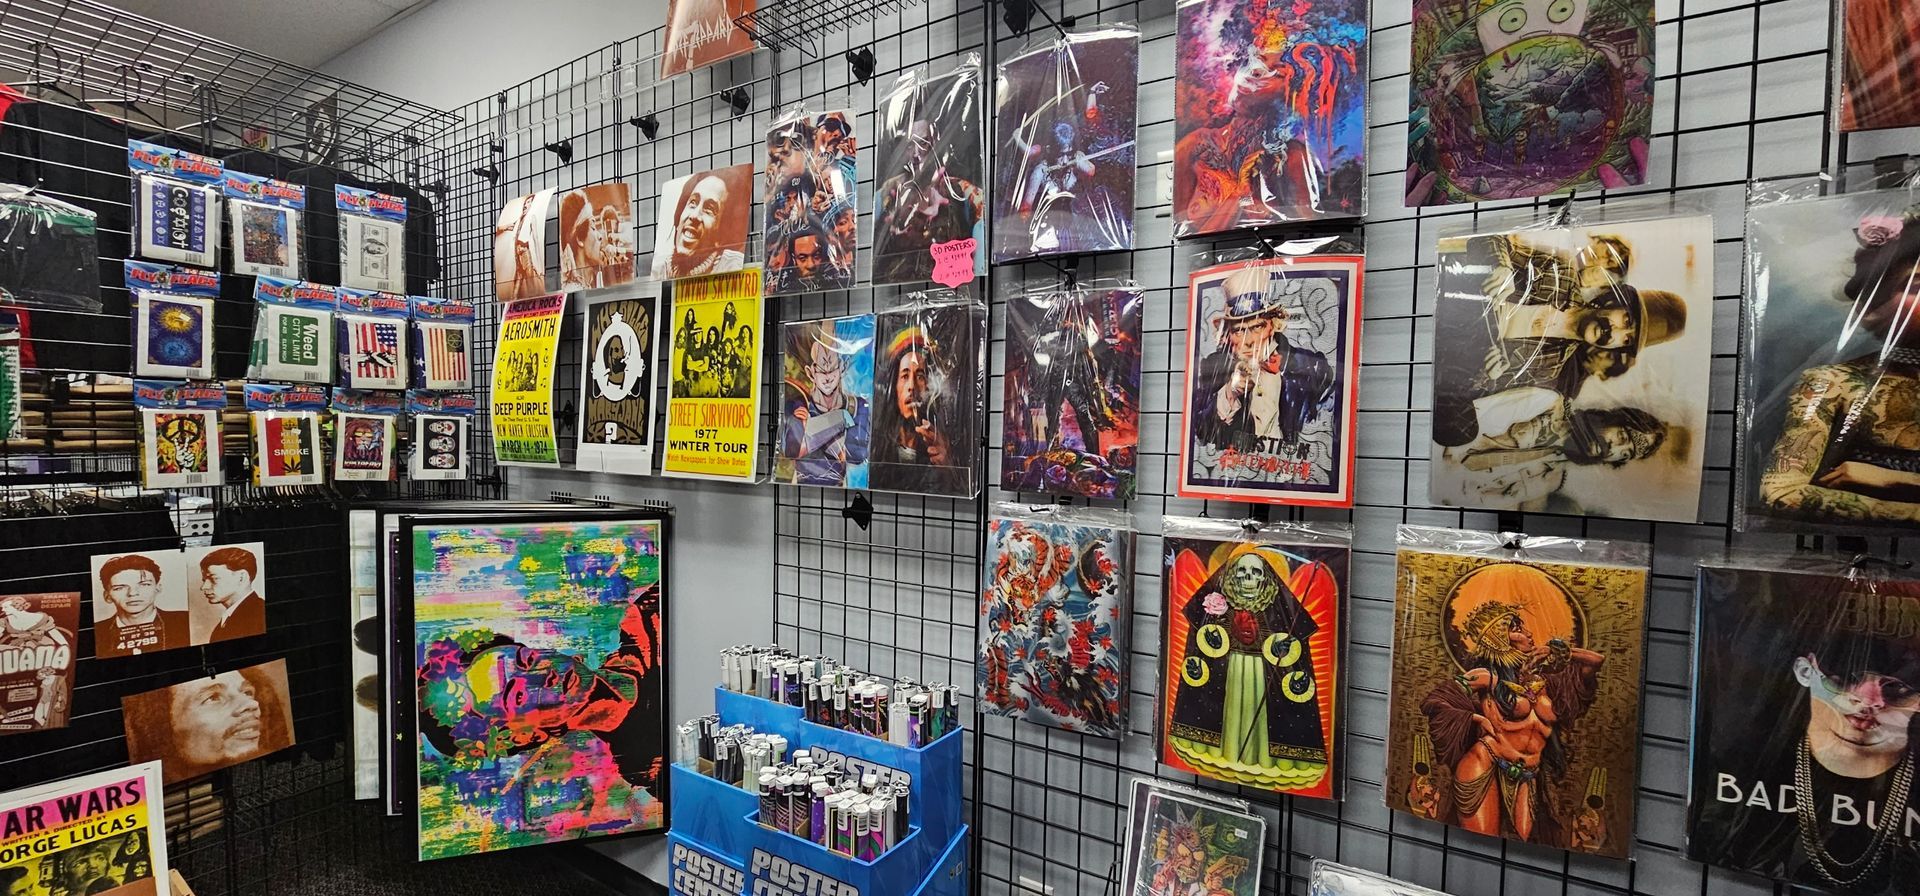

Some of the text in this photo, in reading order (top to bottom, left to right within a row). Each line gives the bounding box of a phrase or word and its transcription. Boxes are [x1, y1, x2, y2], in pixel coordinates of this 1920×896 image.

[132, 149, 161, 166] FLY
[172, 158, 222, 178] FLAGS
[227, 177, 251, 193] FLY
[261, 185, 303, 201] FLAGS
[130, 268, 218, 288] FLY FLAGS
[675, 278, 709, 303] LYNYRD
[712, 272, 759, 300] SKYNYRD
[260, 283, 335, 302] FLY FLAGS
[507, 295, 563, 314] AMERICA ROCKS
[292, 317, 301, 363] CITY LIMIT
[503, 317, 557, 341] AEROSMITH
[302, 323, 319, 360] Weed
[137, 387, 225, 400] FLY FLAGS
[251, 391, 325, 403] FLY FLAGS
[494, 402, 548, 416] DEEP PURPLE
[669, 402, 752, 429] STREET SURVIVORS
[496, 424, 550, 438] NEW HAVEN COLISEUM
[695, 429, 718, 440] 1977
[273, 448, 310, 457] SMOKE
[500, 440, 522, 453] MARCH
[669, 440, 748, 454] WINTER TOUR
[116, 636, 158, 650] 42799
[0, 644, 71, 675] UANA
[56, 780, 141, 823] WARS
[1716, 772, 1799, 814] BAD
[2, 832, 40, 847] WRITTEN
[53, 818, 93, 833] DIRECTED
[69, 813, 137, 844] LUCAS
[751, 847, 860, 896] POSTER
